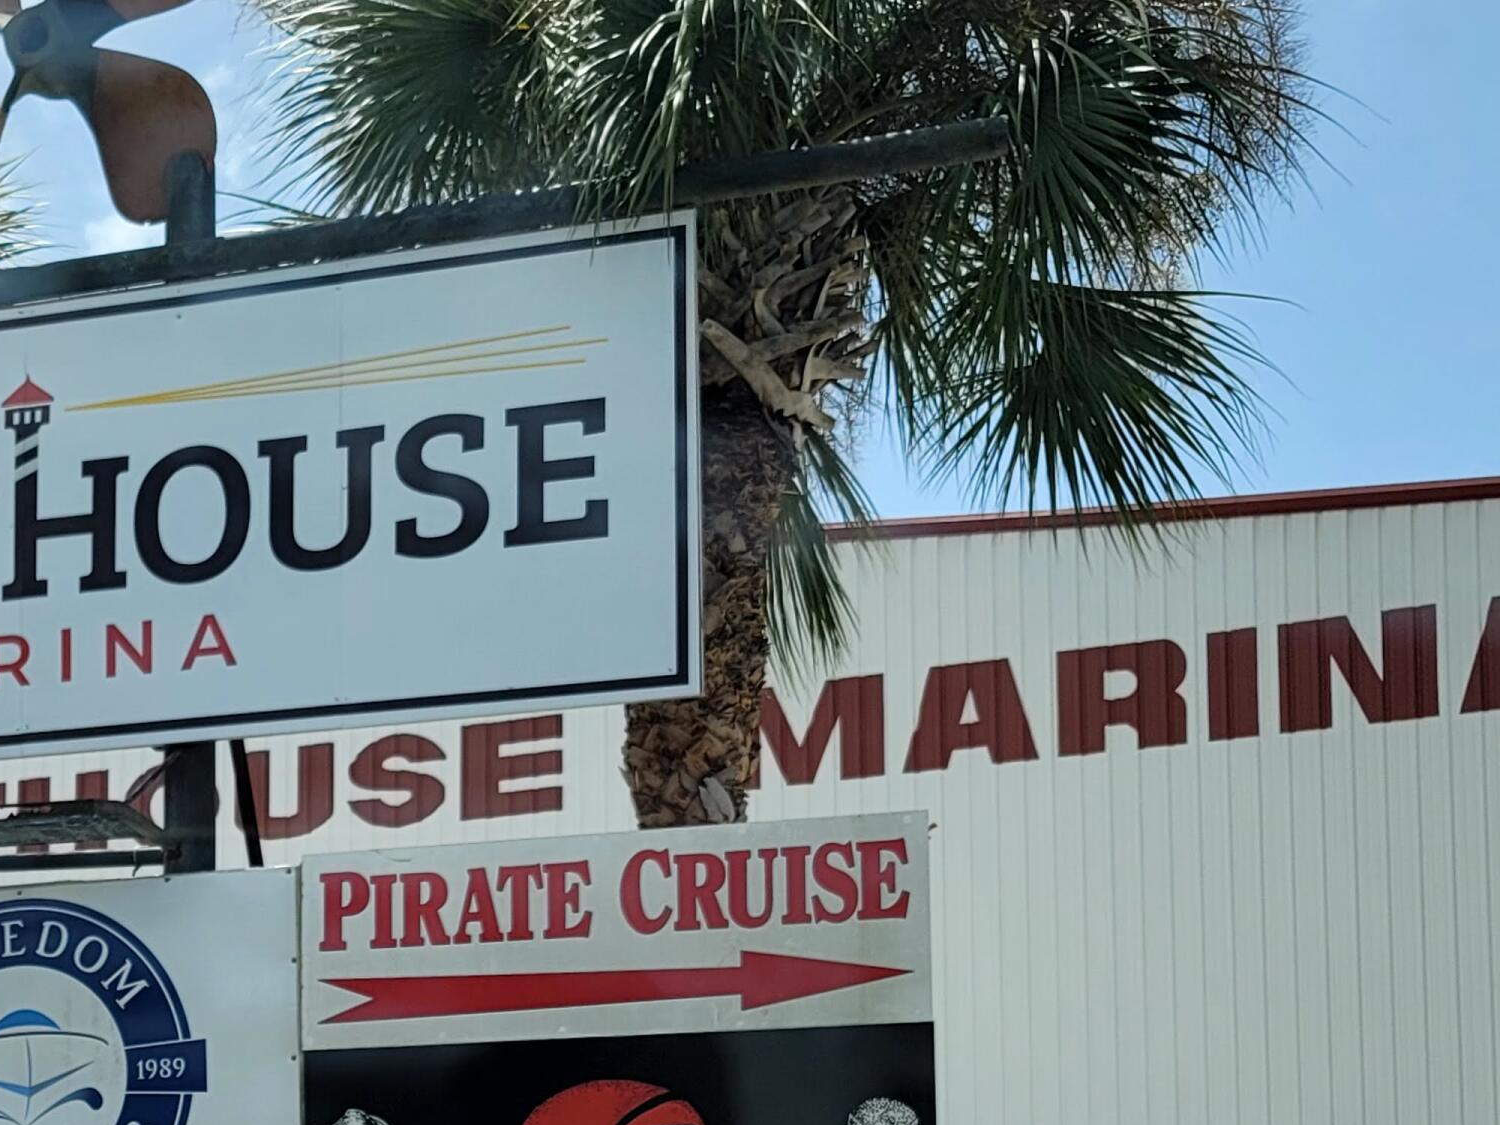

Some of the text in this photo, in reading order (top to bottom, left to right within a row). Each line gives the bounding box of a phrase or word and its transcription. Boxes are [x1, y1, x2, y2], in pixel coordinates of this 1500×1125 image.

[744, 596, 1500, 790] MARIN
[318, 837, 912, 952] PIRATE CRUISE
[135, 1057, 187, 1080] 1989
